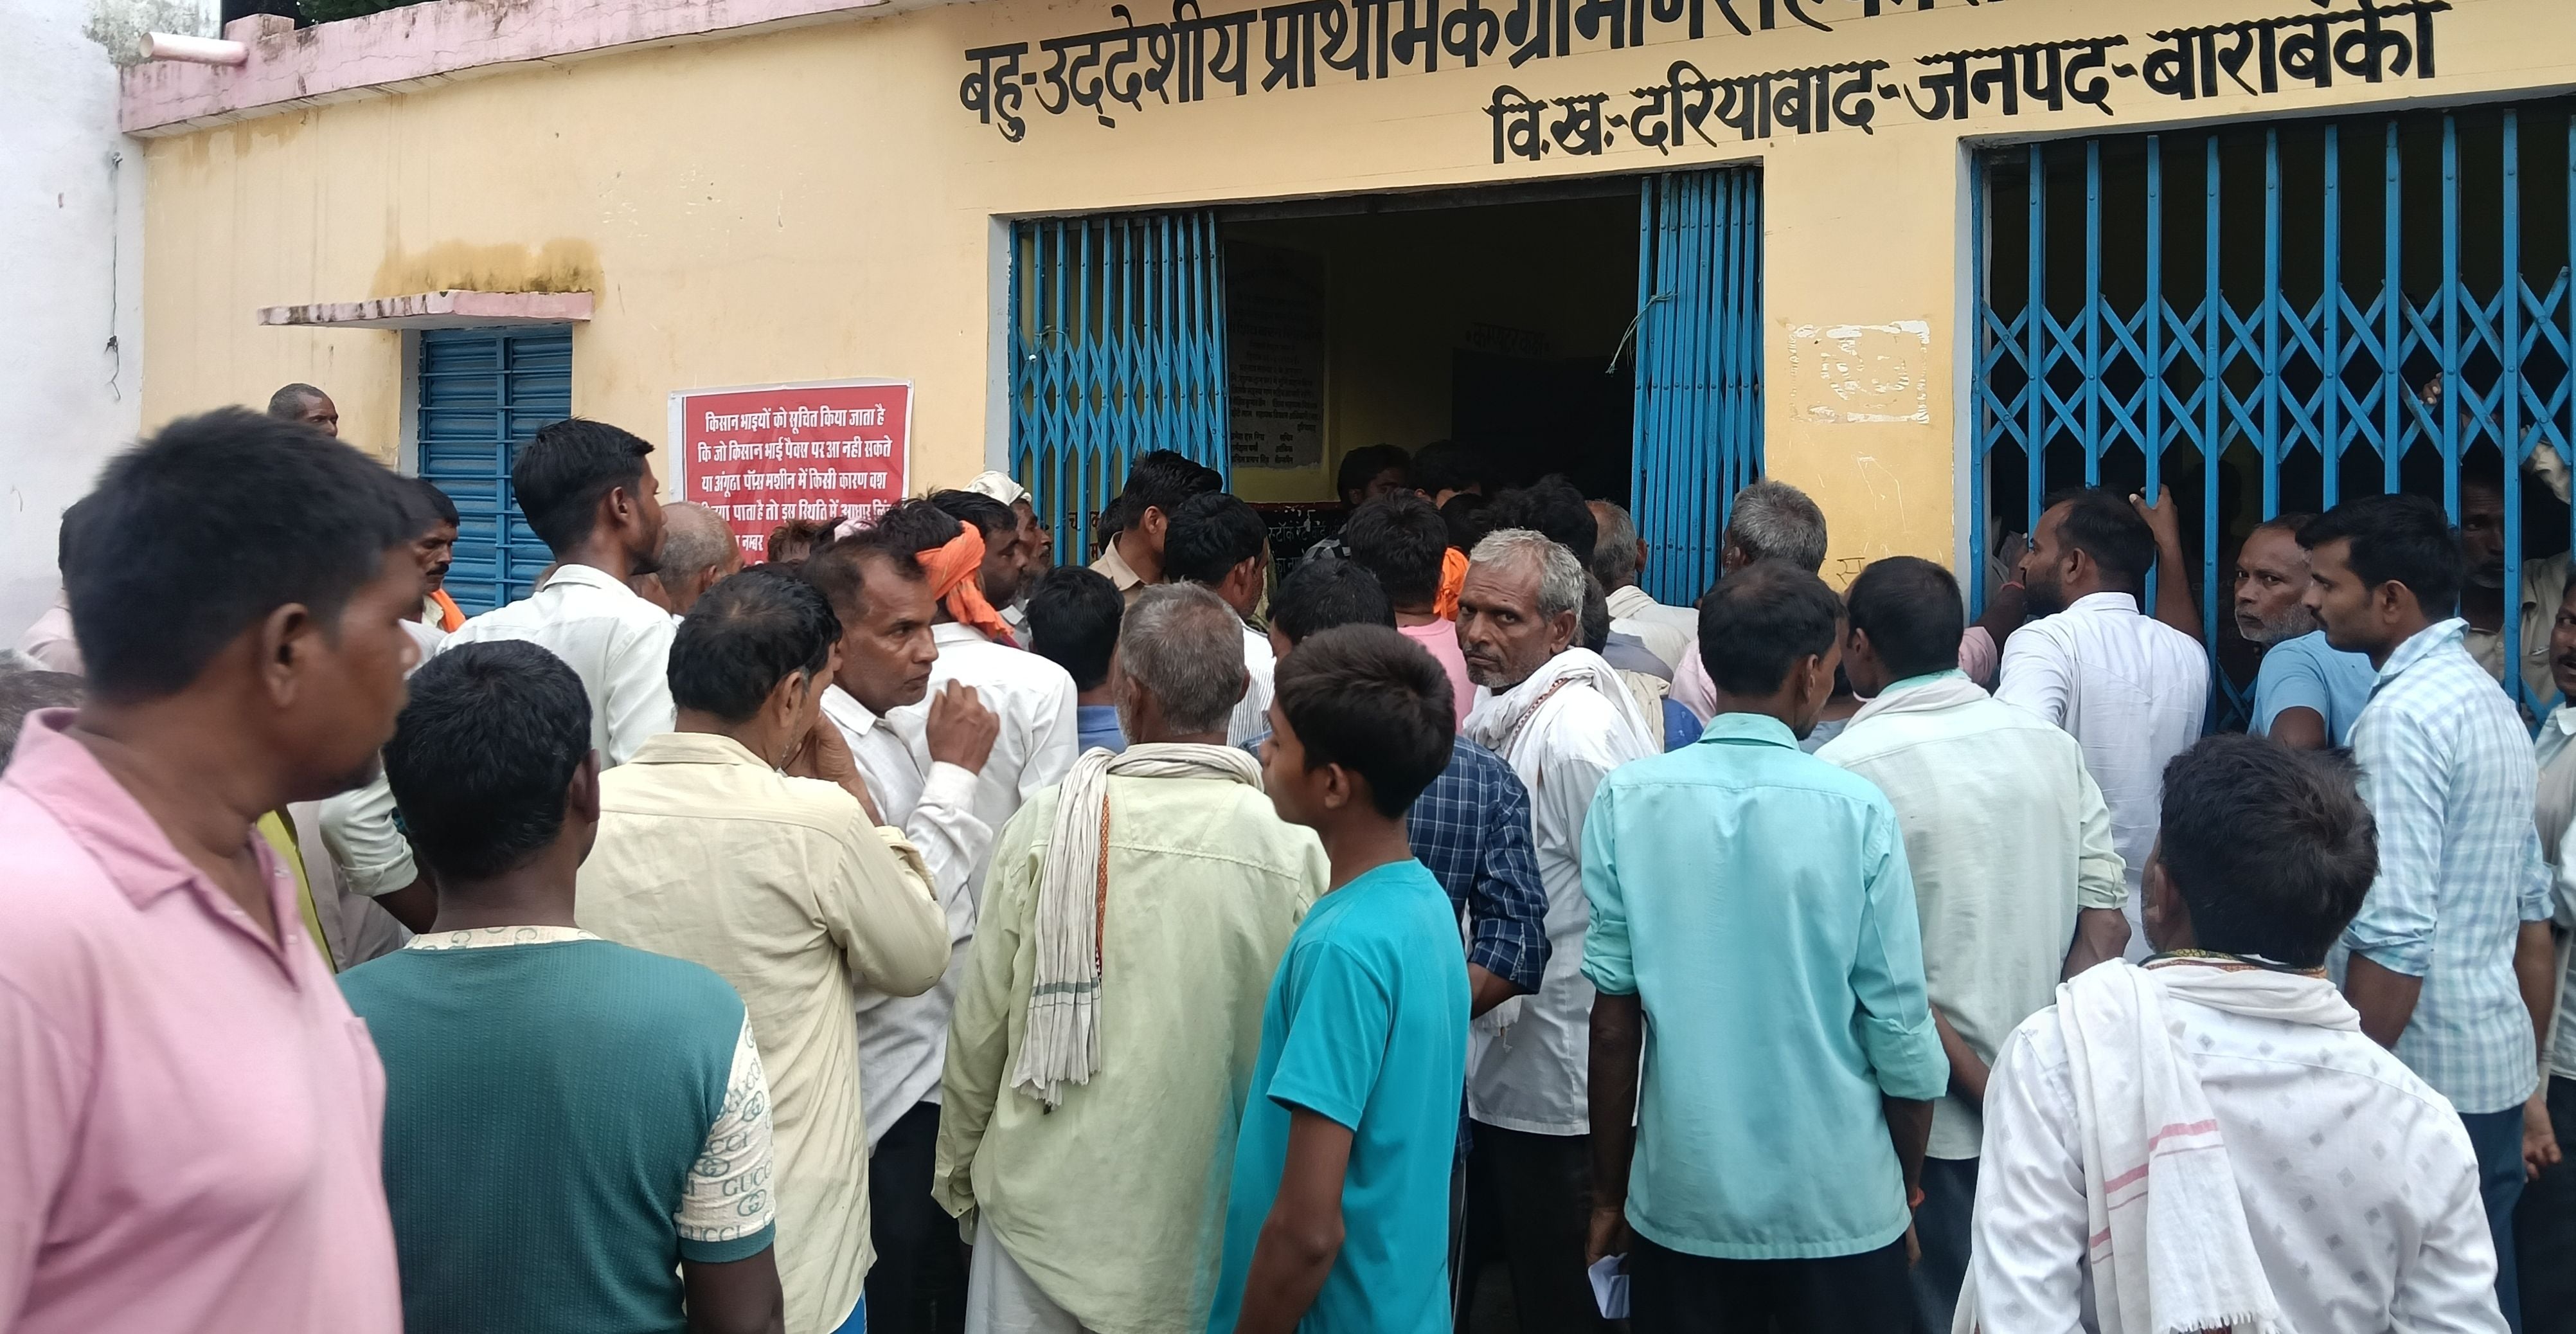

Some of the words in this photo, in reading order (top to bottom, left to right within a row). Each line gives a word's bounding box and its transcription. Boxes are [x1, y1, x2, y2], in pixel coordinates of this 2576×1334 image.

[705, 411, 739, 432] किसान
[740, 408, 771, 431] भाइयों
[773, 407, 787, 429] को
[789, 406, 818, 434] सूचित
[820, 406, 846, 427] किया
[848, 408, 876, 426] जाता
[875, 404, 886, 426] है
[698, 442, 712, 463] कि
[713, 441, 727, 462] जो
[729, 440, 763, 461] किसान
[765, 436, 785, 462] भाई
[783, 437, 809, 458] पैक्स
[811, 442, 825, 458] पर
[826, 441, 840, 458] आ
[842, 435, 862, 458] नही
[864, 435, 893, 458] सकते
[701, 475, 713, 492] या
[714, 471, 740, 498] अंगूठा
[765, 468, 796, 490] मशीन
[798, 468, 809, 490] में
[809, 467, 836, 489] किसी
[839, 472, 868, 489] कारण
[869, 472, 887, 489] वश
[733, 504, 756, 520] पाता
[756, 499, 764, 520] है
[765, 499, 780, 520] तो
[782, 503, 796, 523] इस
[798, 499, 827, 520] स्थिति
[829, 499, 839, 518] में
[742, 534, 764, 551] नम्बर
